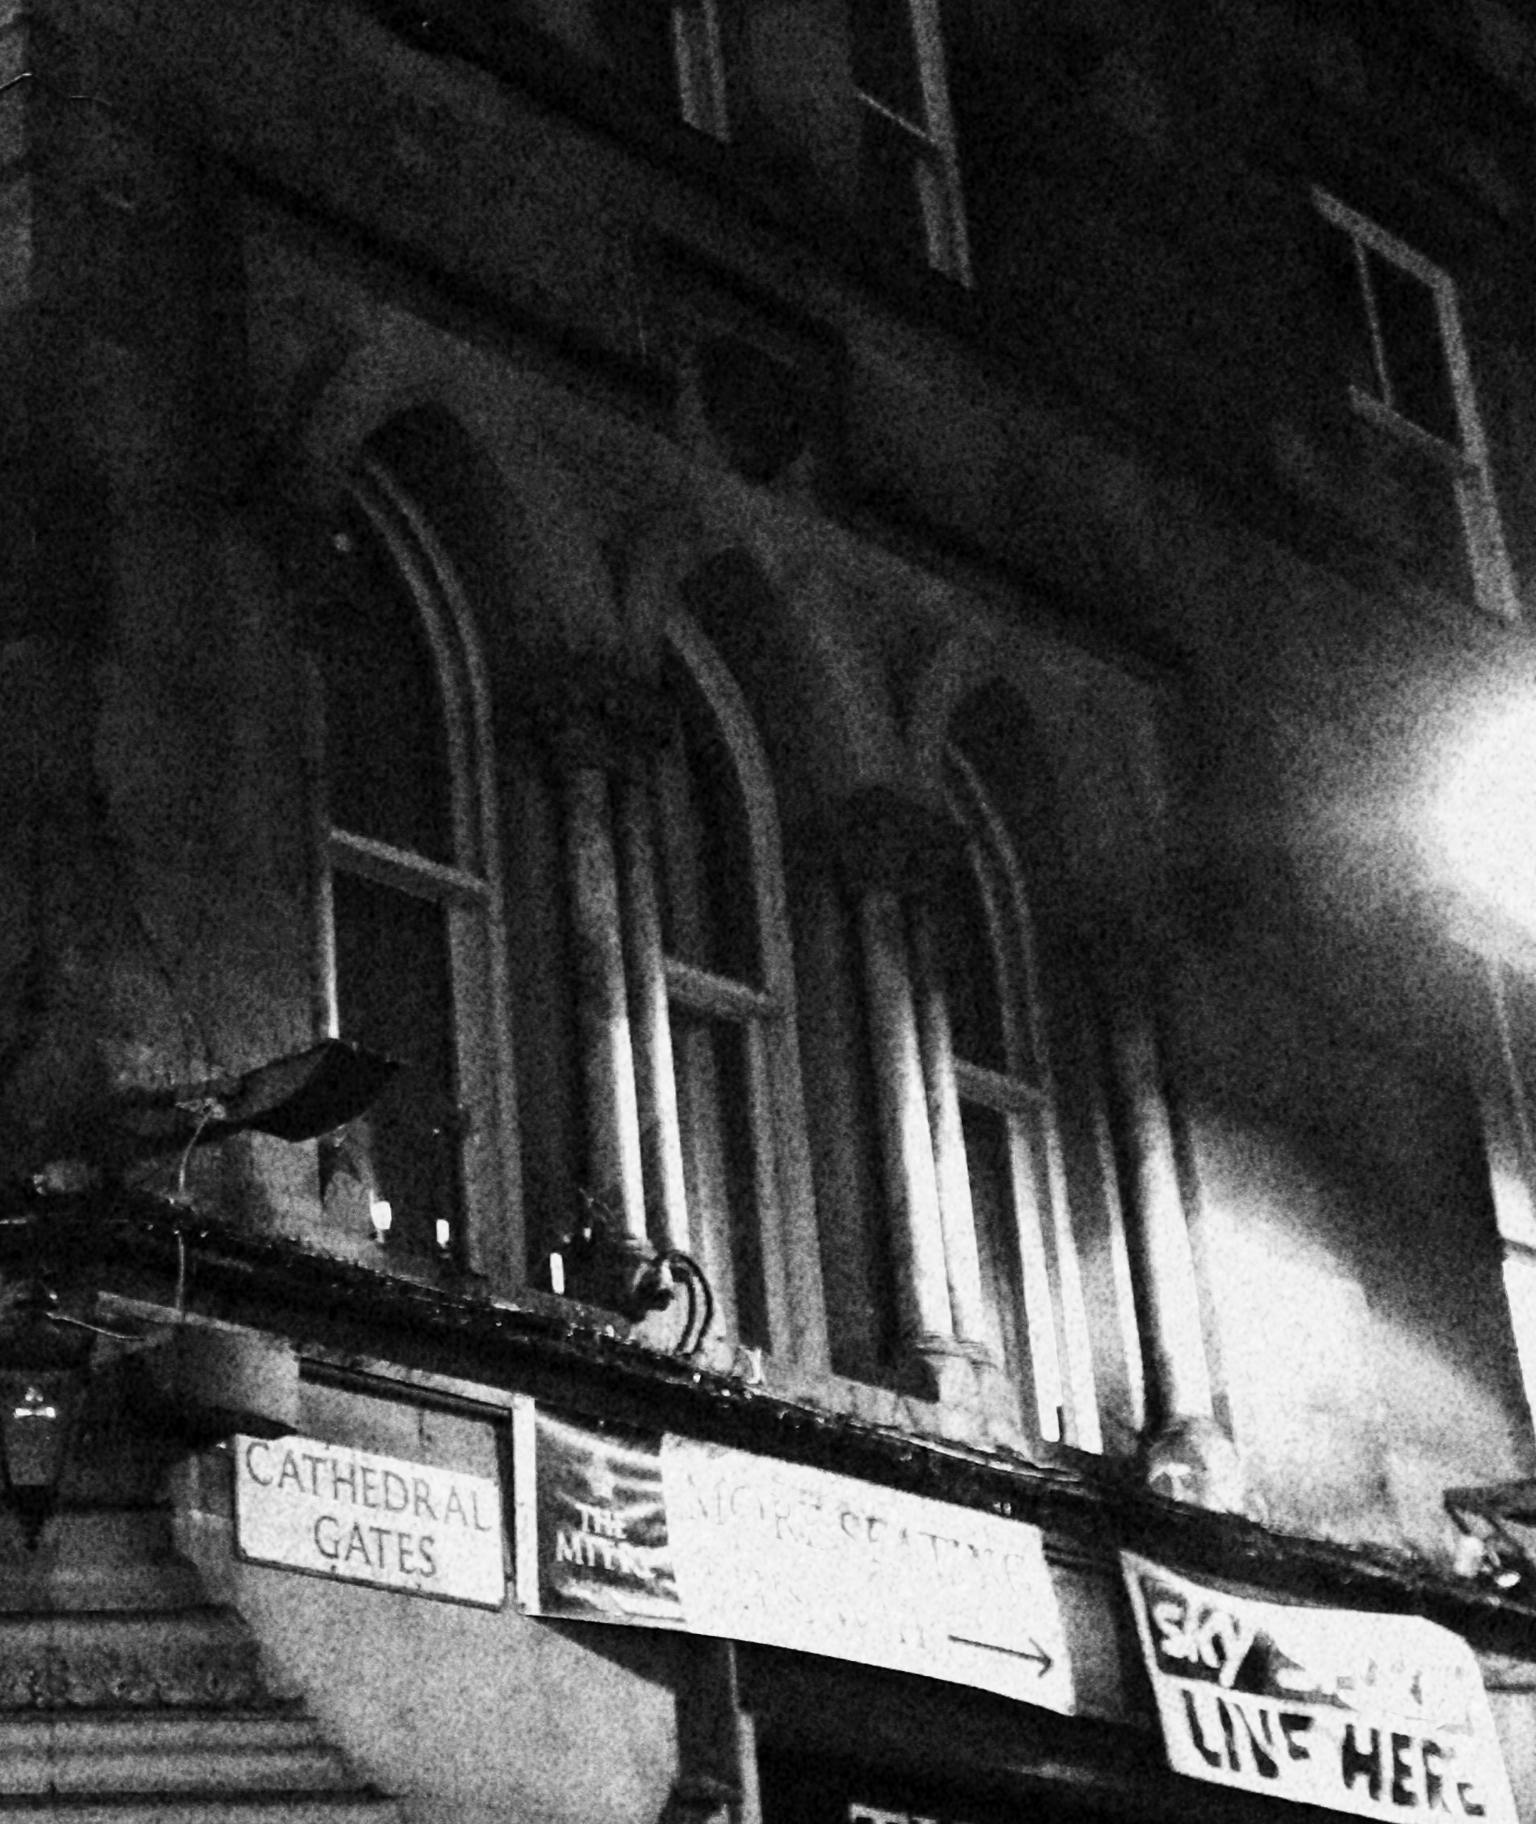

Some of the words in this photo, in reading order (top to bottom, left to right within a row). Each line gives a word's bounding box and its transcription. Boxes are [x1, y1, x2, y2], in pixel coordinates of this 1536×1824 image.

[245, 1442, 493, 1532] CATHEDRAL
[314, 1516, 437, 1578] GATES
[575, 1503, 627, 1539] THE
[555, 1530, 669, 1580] MITR
[1181, 1688, 1313, 1779] LIVE
[1342, 1723, 1486, 1816] HERE
